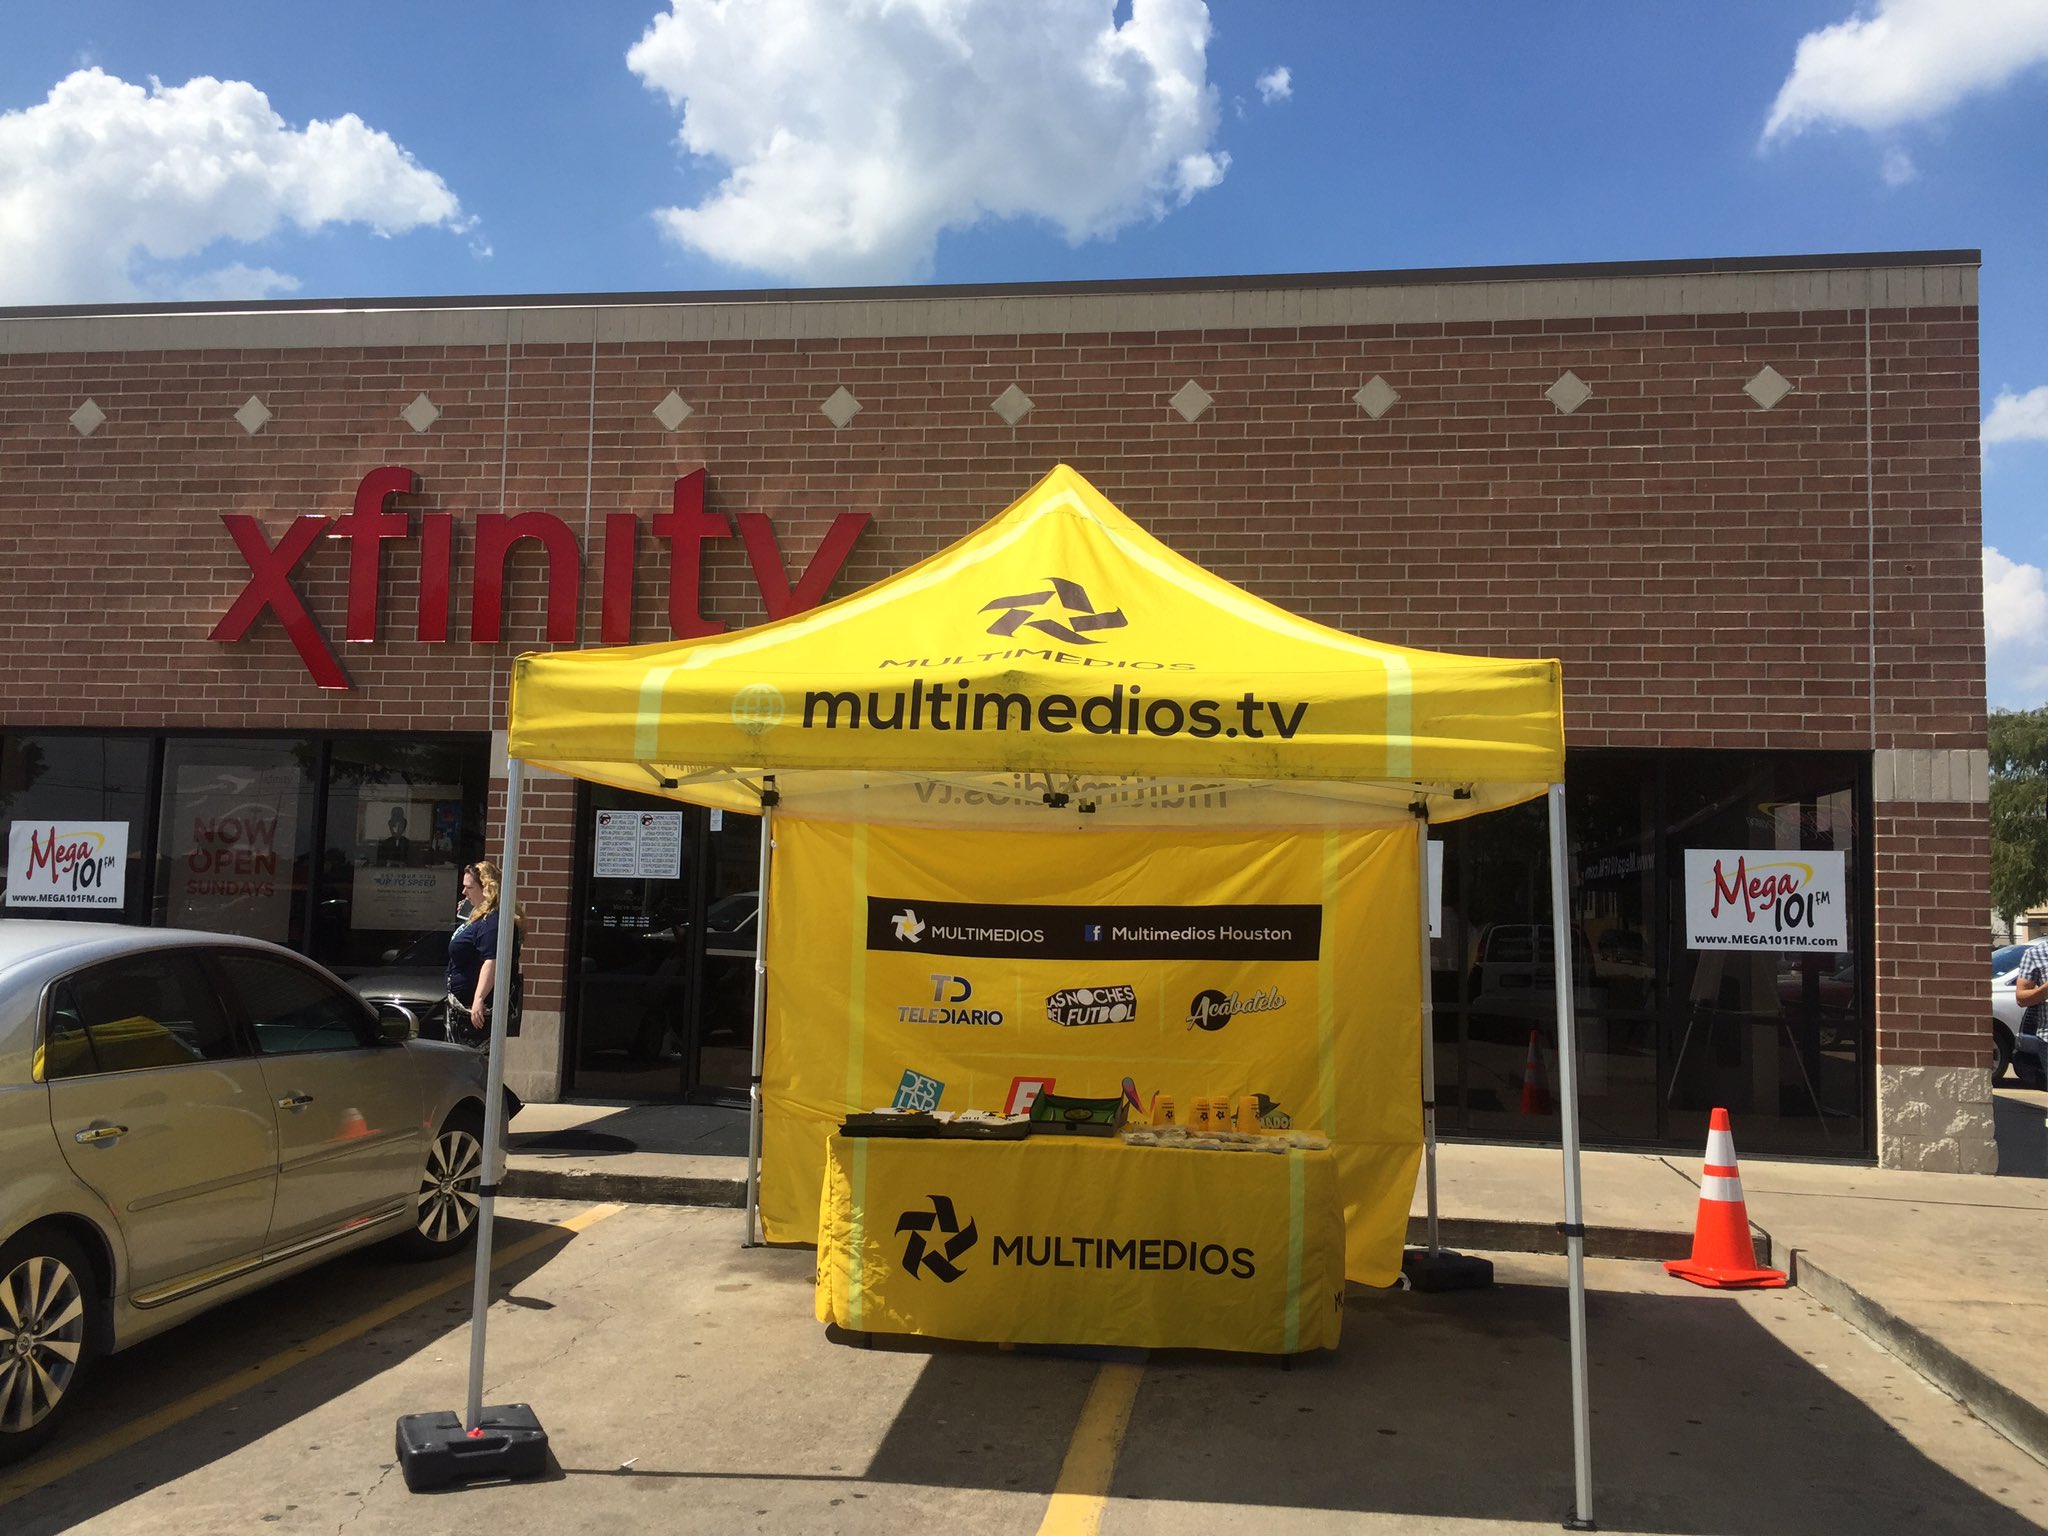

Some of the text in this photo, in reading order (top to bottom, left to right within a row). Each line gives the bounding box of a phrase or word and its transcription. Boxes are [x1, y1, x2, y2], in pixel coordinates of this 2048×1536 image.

[206, 466, 872, 690] xfinity
[878, 648, 1196, 671] MULTIMEDIOS
[802, 678, 1309, 739] multimedios.tv
[193, 815, 279, 845] NOW
[26, 826, 93, 884] Mega
[188, 849, 277, 875] OPEN
[72, 856, 115, 892] 101 FM
[12, 894, 118, 903] www.MEGA101FM.com
[186, 880, 275, 896] SUNDAYS
[1711, 856, 1799, 923] Mega
[1774, 891, 1831, 932] 101 FM
[931, 926, 1045, 943] MULTIMEDIOS
[1112, 926, 1216, 941] Multimedios
[1220, 926, 1292, 940] Houston
[1695, 934, 1838, 946] www.MEGA101FM.com
[1047, 987, 1135, 1008] LAS NOCHES
[898, 1006, 1004, 1026] TELEDIARIO
[1047, 1003, 1135, 1026] DEL FUTBOL
[992, 1235, 1255, 1279] MULTIMEDIOS
